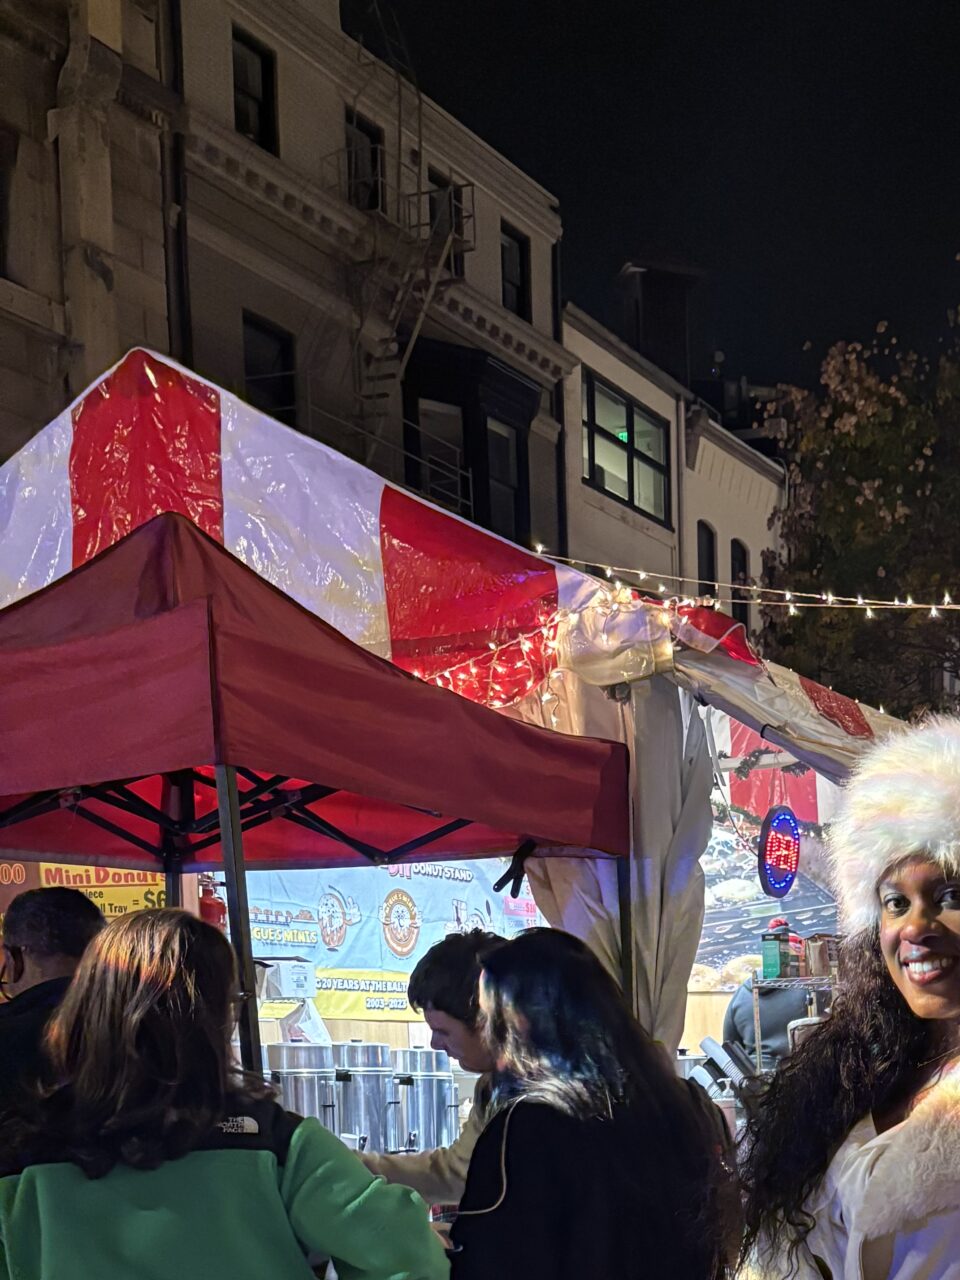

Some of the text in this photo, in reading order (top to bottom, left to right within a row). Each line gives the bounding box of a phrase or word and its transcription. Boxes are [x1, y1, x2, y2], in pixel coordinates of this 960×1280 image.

[0, 863, 25, 884] 00
[44, 867, 91, 885] Mini
[443, 867, 474, 883] STAND
[332, 978, 360, 991] YEARS
[386, 981, 407, 994] BALT
